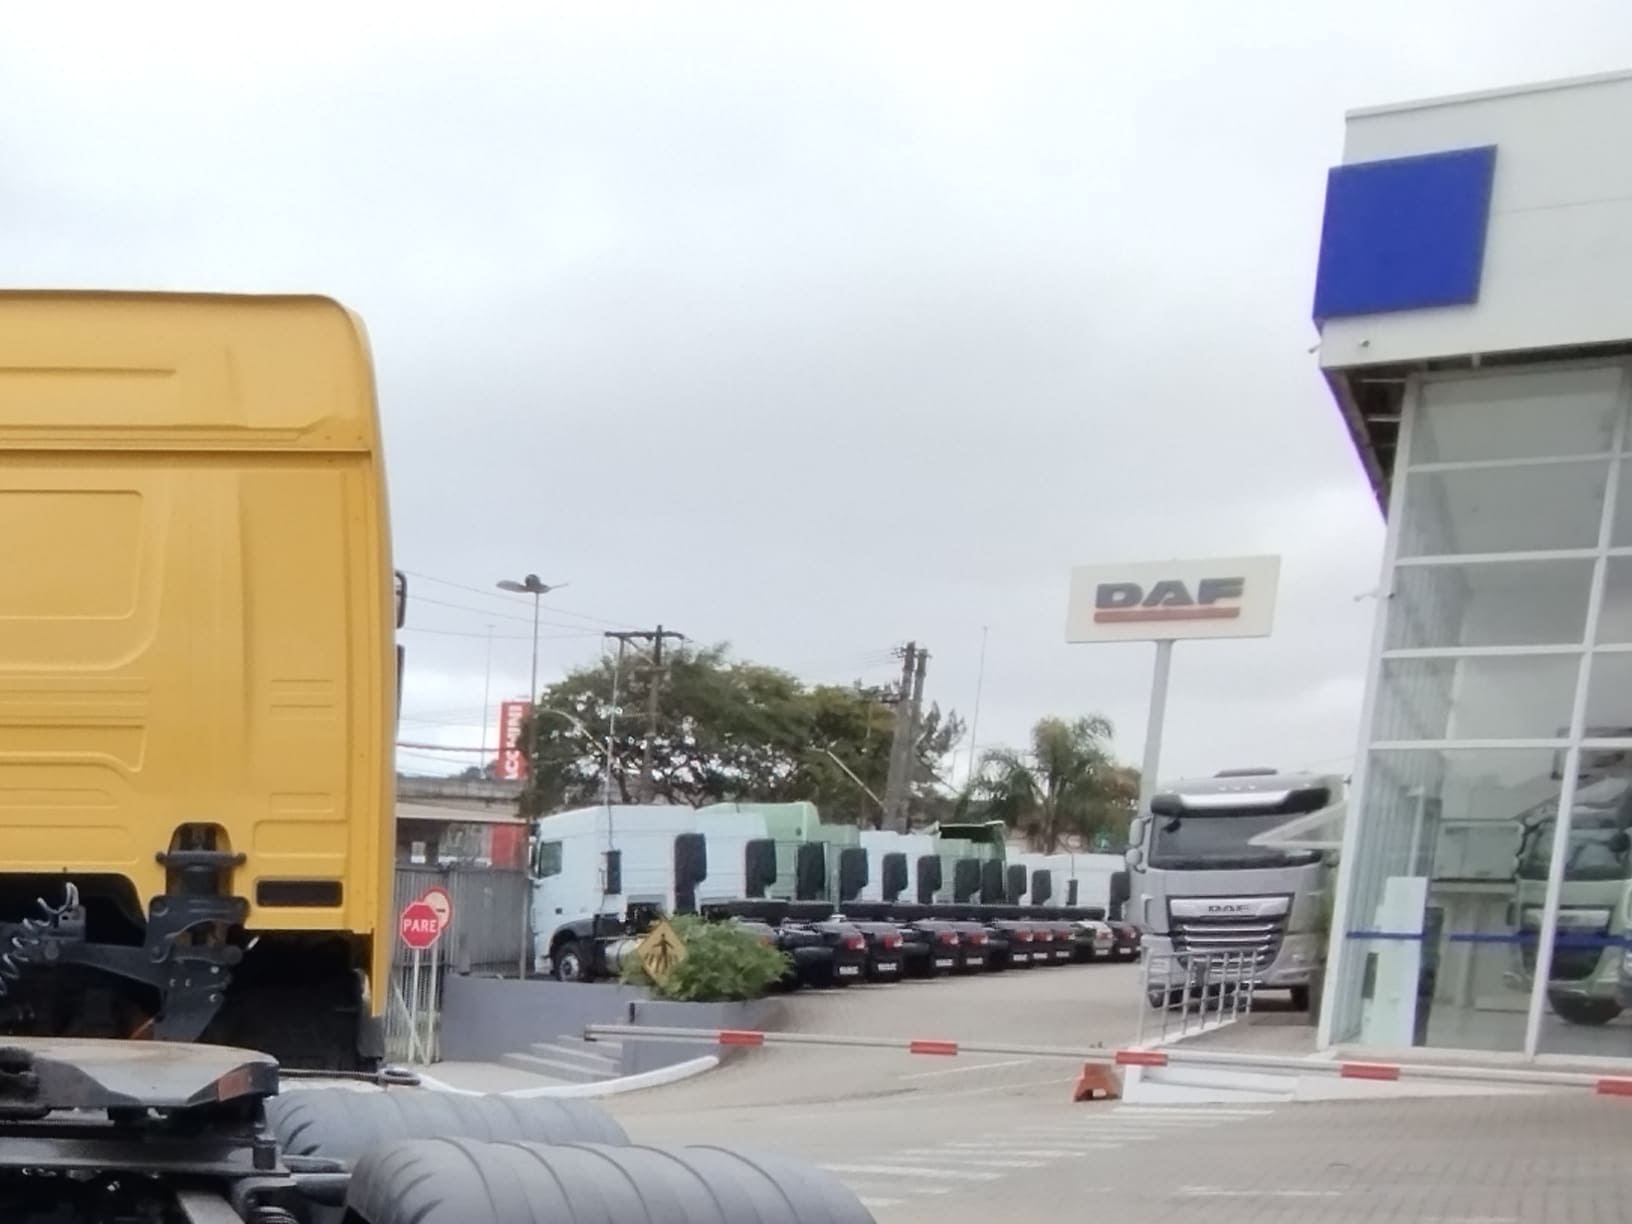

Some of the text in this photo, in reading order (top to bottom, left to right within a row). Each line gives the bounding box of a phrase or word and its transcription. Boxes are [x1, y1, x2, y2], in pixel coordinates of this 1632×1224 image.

[1095, 577, 1245, 608] DAF
[1208, 904, 1249, 912] DAF
[403, 919, 437, 933] PARE
